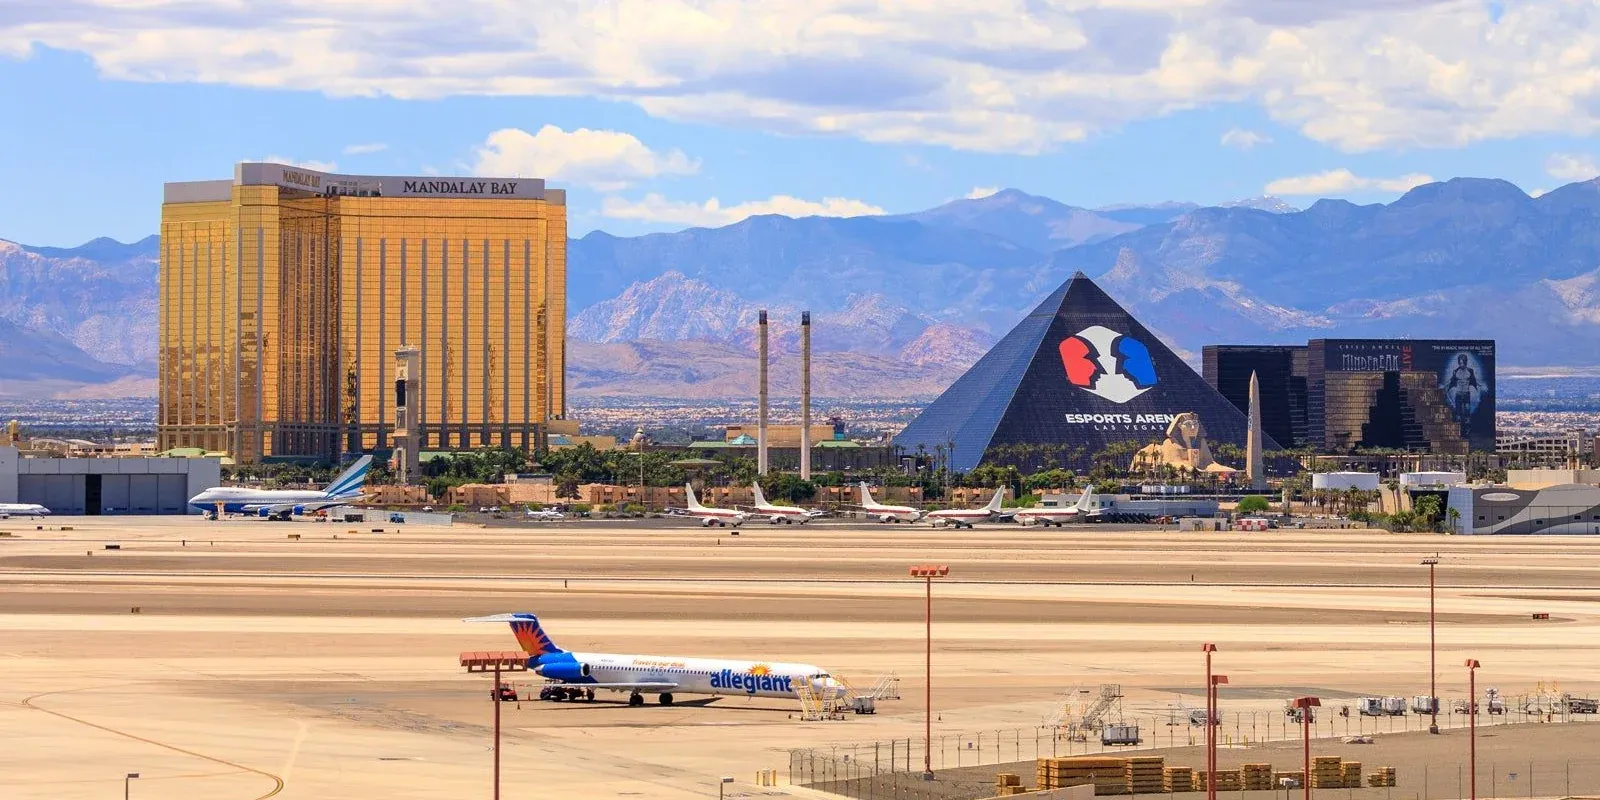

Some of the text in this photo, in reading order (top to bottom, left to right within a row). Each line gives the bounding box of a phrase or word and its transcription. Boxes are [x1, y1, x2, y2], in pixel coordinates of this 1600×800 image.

[403, 181, 517, 194] MANDALAY BAY
[1342, 354, 1399, 371] MINDFREAK
[1402, 344, 1412, 371] LIVE
[1065, 414, 1174, 424] ESPORTS AREN
[710, 669, 792, 693] allegiant
